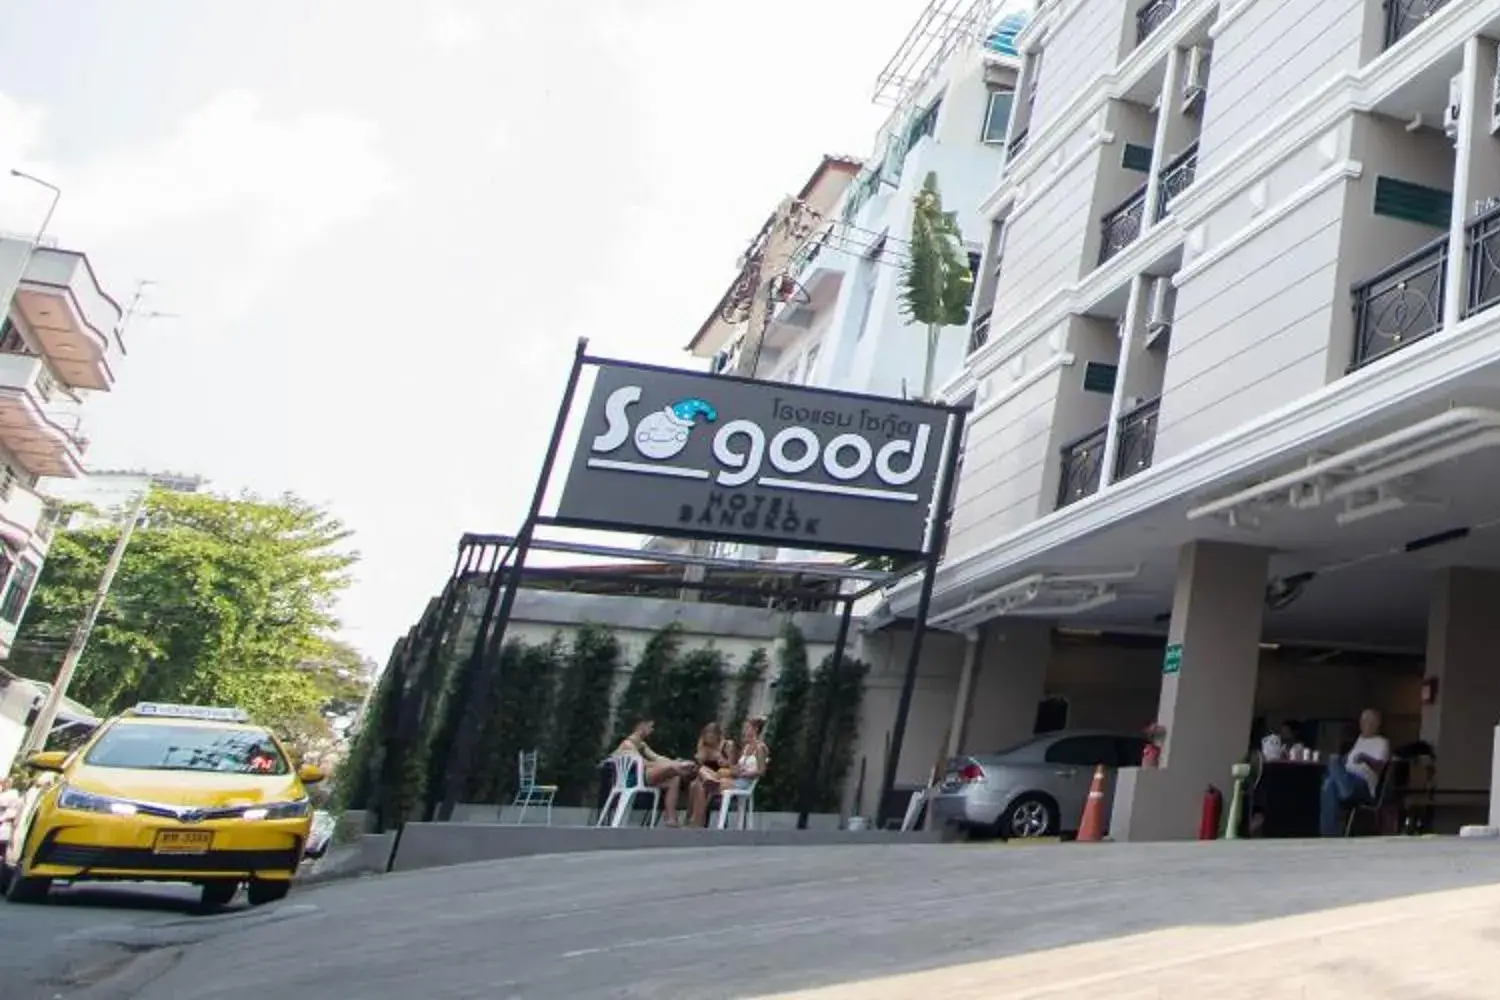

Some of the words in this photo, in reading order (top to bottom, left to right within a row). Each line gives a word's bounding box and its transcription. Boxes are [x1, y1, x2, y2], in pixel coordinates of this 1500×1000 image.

[712, 419, 930, 487] good
[708, 491, 797, 514] HOTEL
[678, 504, 821, 535] BANGKOK
